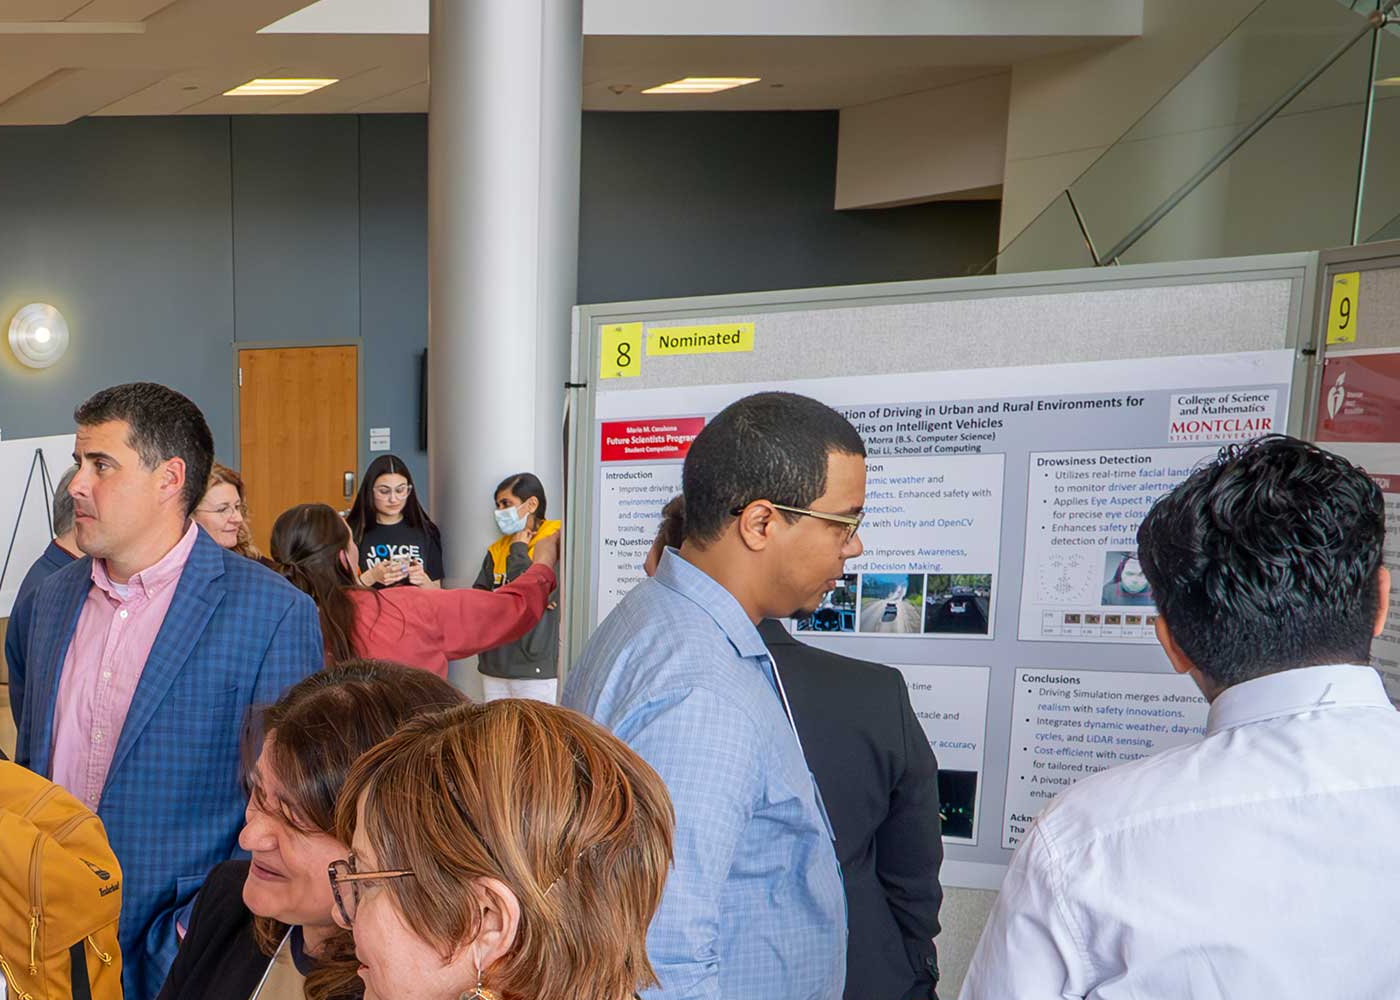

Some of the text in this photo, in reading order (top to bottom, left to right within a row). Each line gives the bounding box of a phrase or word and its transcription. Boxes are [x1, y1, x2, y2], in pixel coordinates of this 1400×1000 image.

[1339, 297, 1350, 330] 9
[659, 330, 740, 348] Nominated
[616, 342, 631, 367] 8
[1178, 393, 1269, 406] College of Science
[873, 396, 1144, 419] of Driving in Urban and Rural Environments for
[1180, 404, 1265, 416] and Mathematics
[879, 418, 1003, 433] on Intelligent Vehicles
[1171, 418, 1271, 433] MONTCLAIR
[607, 437, 629, 446] Future
[632, 435, 665, 444] Scientists
[916, 434, 958, 443] Computer
[960, 432, 996, 441] Science)
[894, 446, 922, 454] School
[935, 444, 981, 454] Computing
[1037, 455, 1151, 467] Drowsiness Detection
[606, 472, 652, 480] Introduction
[1055, 468, 1165, 479] Utilizes real-time facial
[890, 475, 944, 484] weather and
[898, 489, 992, 499] Enhanced safety with
[893, 519, 916, 528] Unity
[919, 519, 935, 527] and
[938, 519, 973, 528] OpenCV
[1052, 524, 1128, 532] Enhances safety
[605, 538, 617, 546] Key
[367, 545, 420, 558] JOYCE
[876, 549, 915, 557] improves
[852, 562, 867, 570] and
[870, 562, 906, 570] Decision
[1022, 674, 1080, 684] Conclusions
[1039, 688, 1160, 702] Driving Simulation merges
[1038, 704, 1185, 718] realism with safety innovations.
[1037, 717, 1168, 733] Integrates dynamic weather,
[1067, 734, 1084, 743] and
[1086, 735, 1113, 744] LiDAR
[1096, 750, 1117, 760] with
